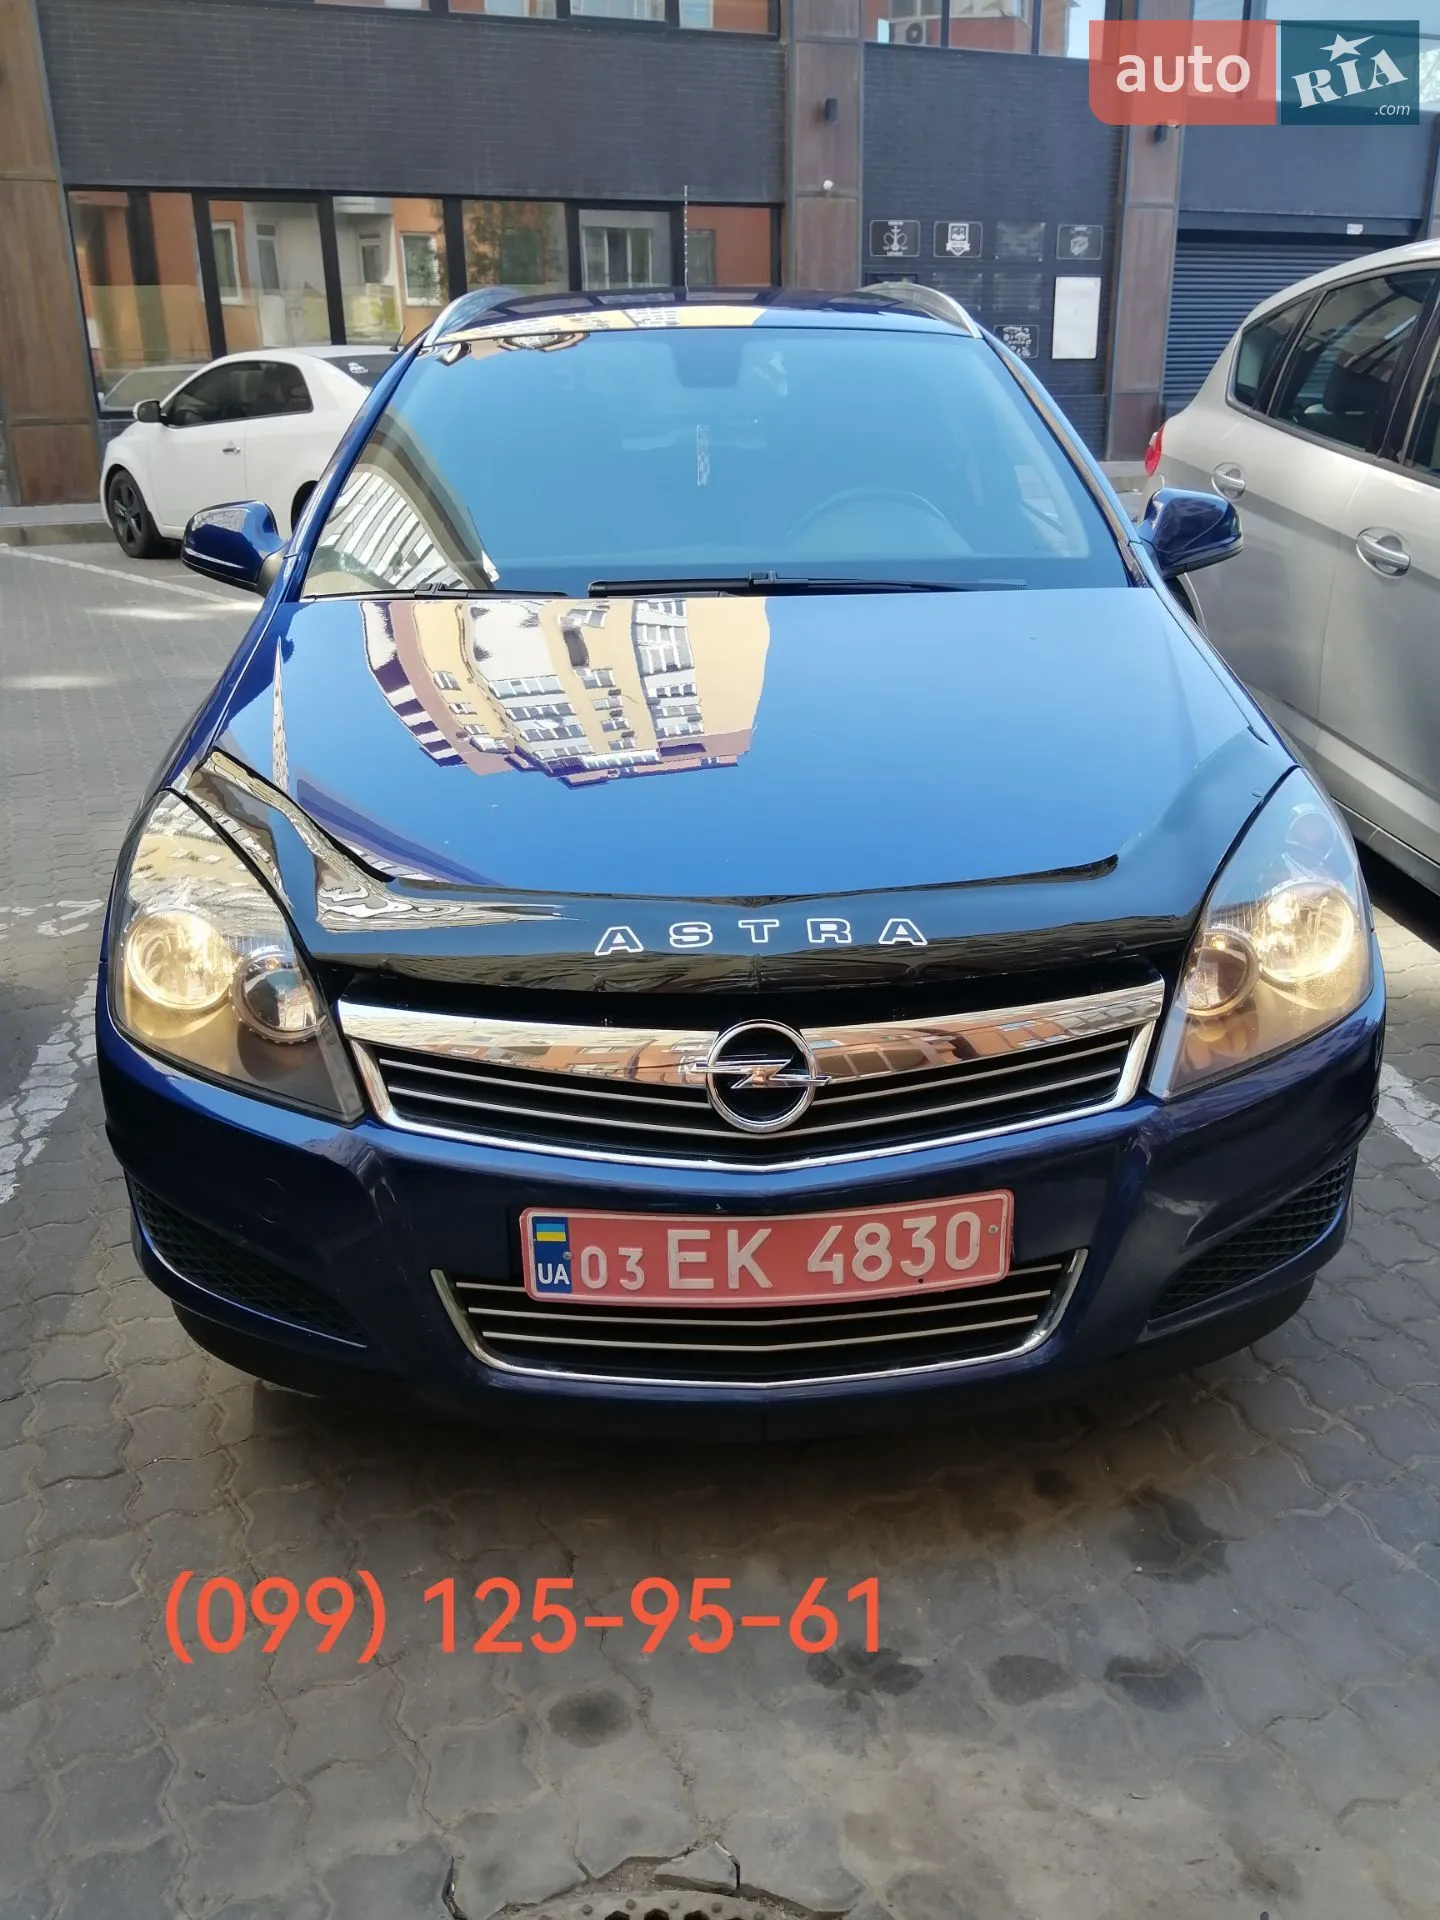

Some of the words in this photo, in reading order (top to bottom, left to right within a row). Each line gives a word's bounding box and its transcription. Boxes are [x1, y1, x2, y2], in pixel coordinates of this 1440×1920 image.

[594, 918, 928, 956] ASTRA
[580, 1246, 645, 1291] 03
[667, 1228, 773, 1290] EK
[807, 1211, 982, 1285] 4830
[537, 1263, 570, 1285] UA
